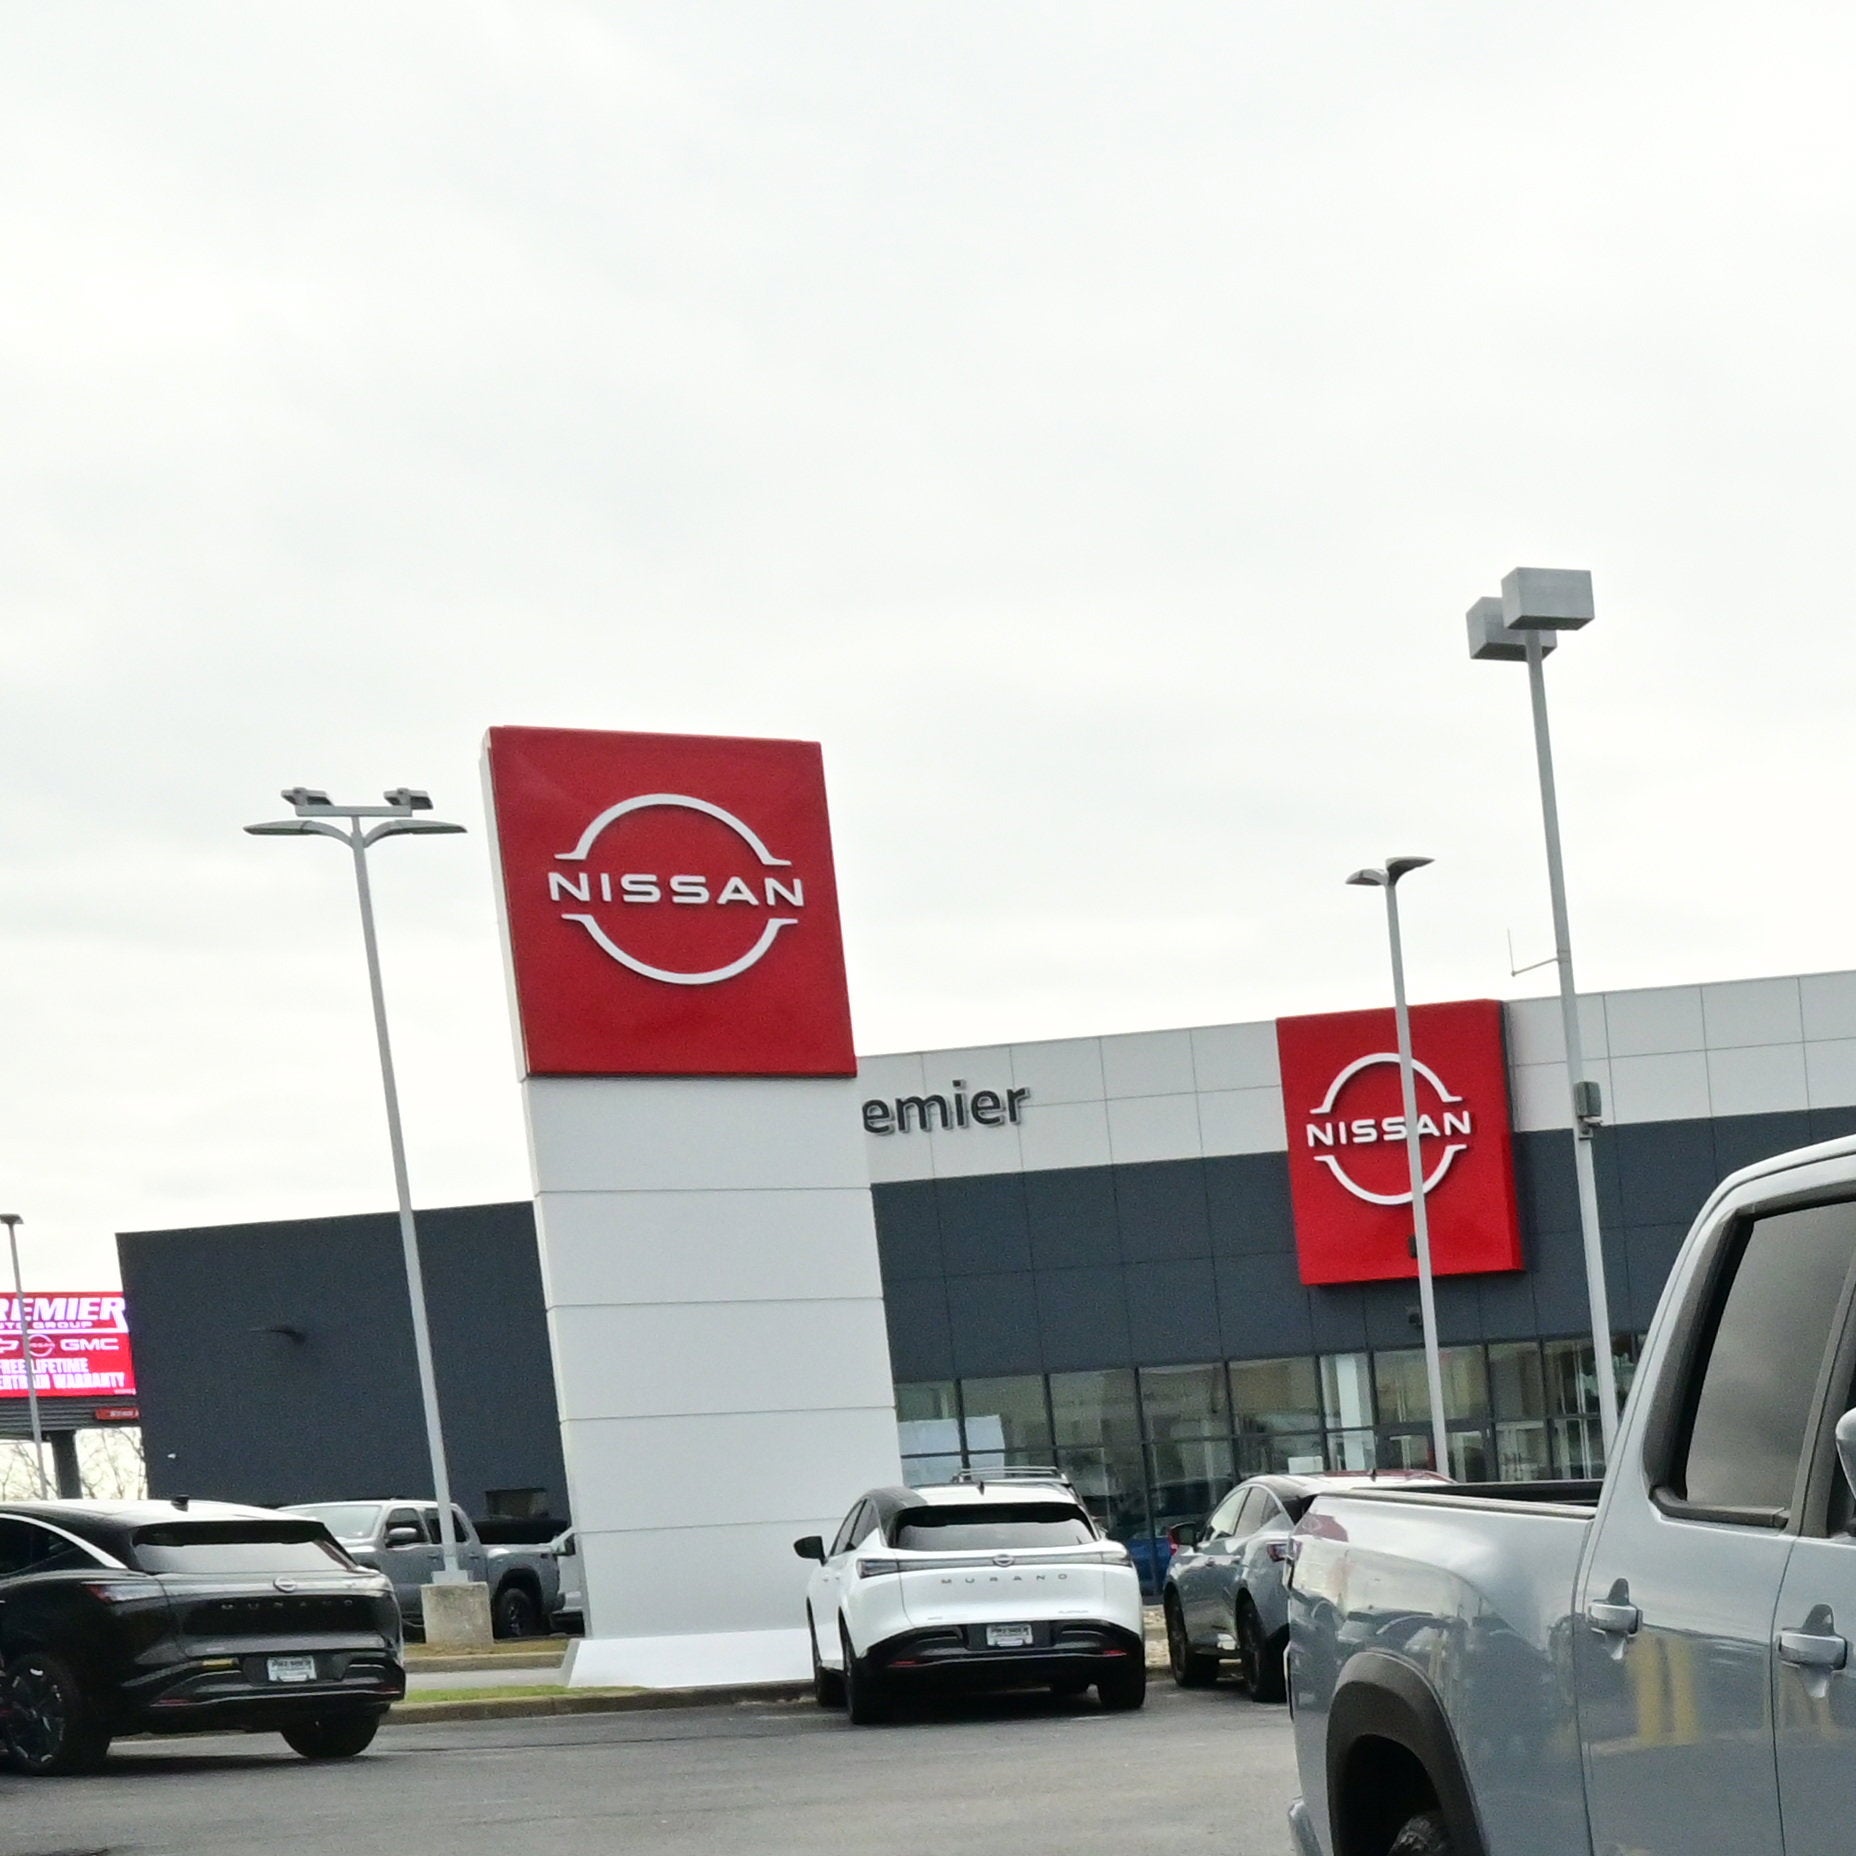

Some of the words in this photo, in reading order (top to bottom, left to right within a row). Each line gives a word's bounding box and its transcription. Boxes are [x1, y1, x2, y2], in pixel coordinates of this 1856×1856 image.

[548, 872, 804, 907] NISSAN
[862, 1079, 1029, 1134] emier
[1306, 1110, 1472, 1147] NISSAN
[32, 1321, 93, 1329] GROUP
[61, 1338, 119, 1351] GMC
[31, 1357, 89, 1374] LIFETIME
[941, 1573, 1068, 1584] MURANO
